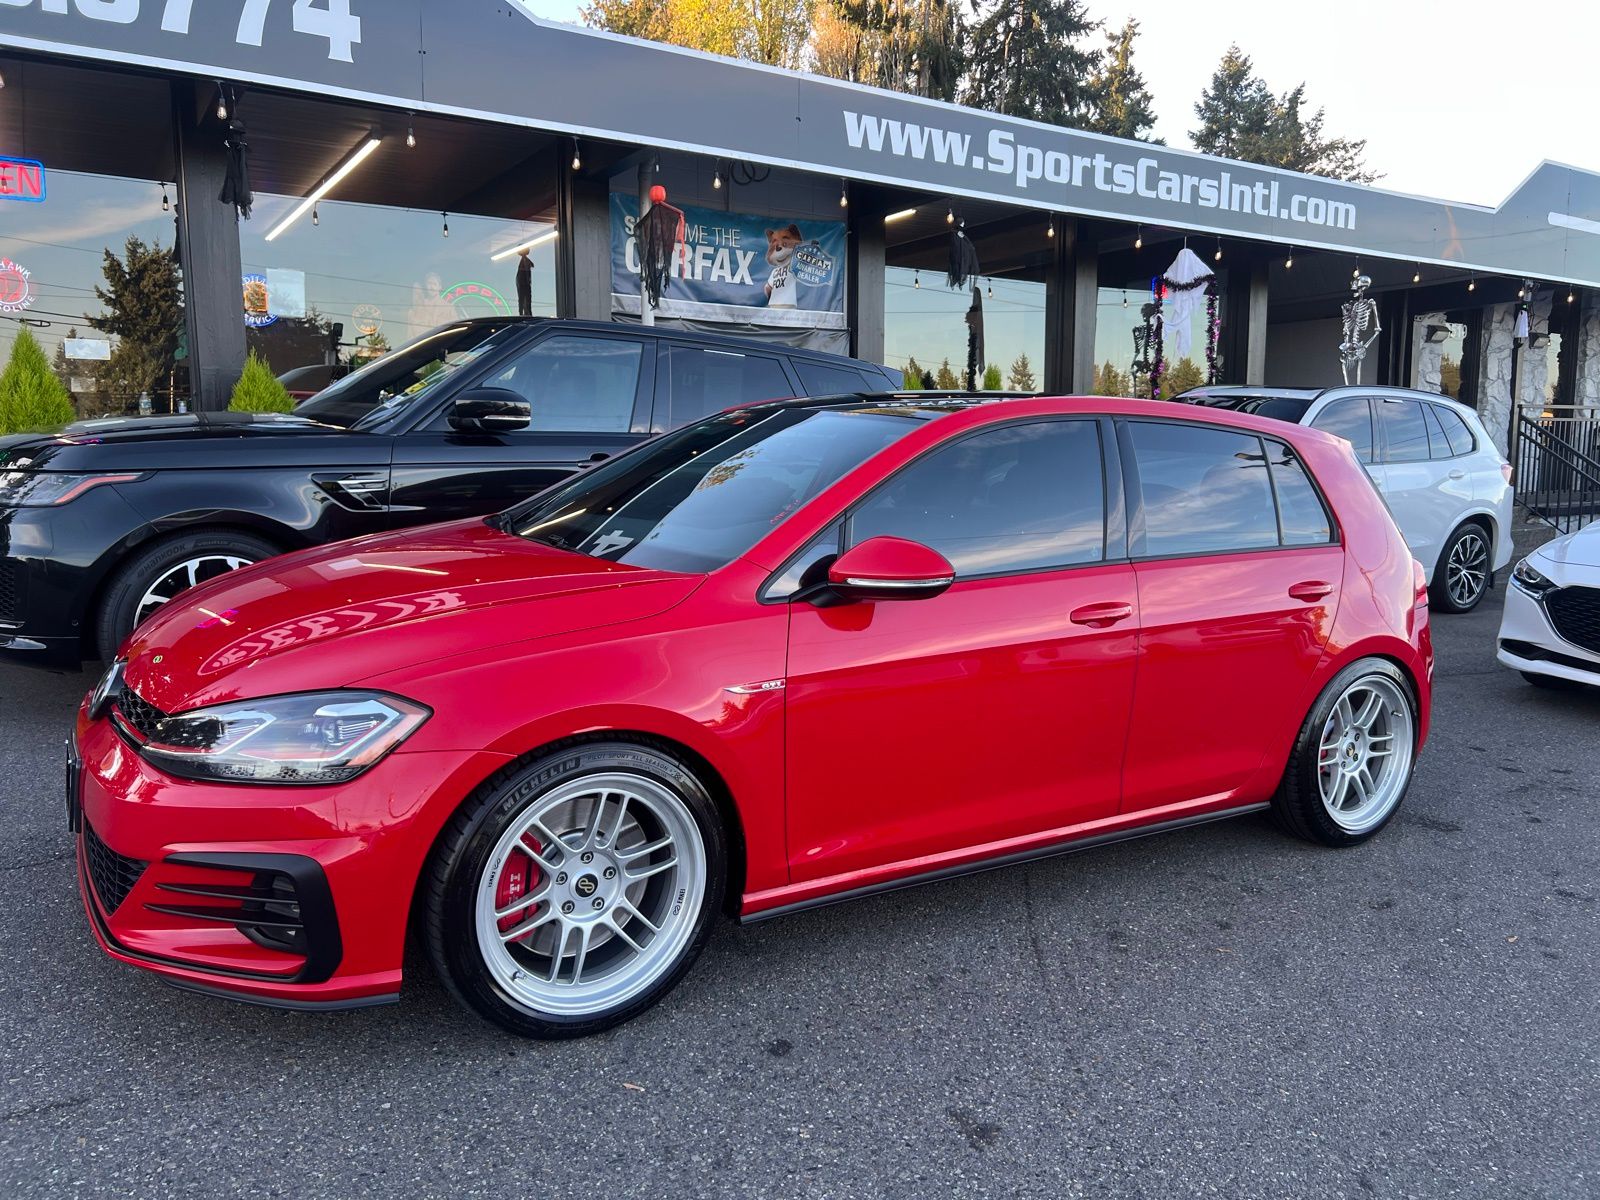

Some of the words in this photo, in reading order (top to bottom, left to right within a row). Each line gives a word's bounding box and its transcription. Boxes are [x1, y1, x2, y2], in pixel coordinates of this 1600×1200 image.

[843, 110, 1356, 230] www.SportsCarsIntl.com
[684, 223, 709, 245] ME
[712, 227, 741, 248] THE
[624, 236, 755, 286] CRFAX
[773, 277, 786, 289] FOX
[502, 758, 576, 811] MICHELIN
[645, 757, 668, 771] SEASON
